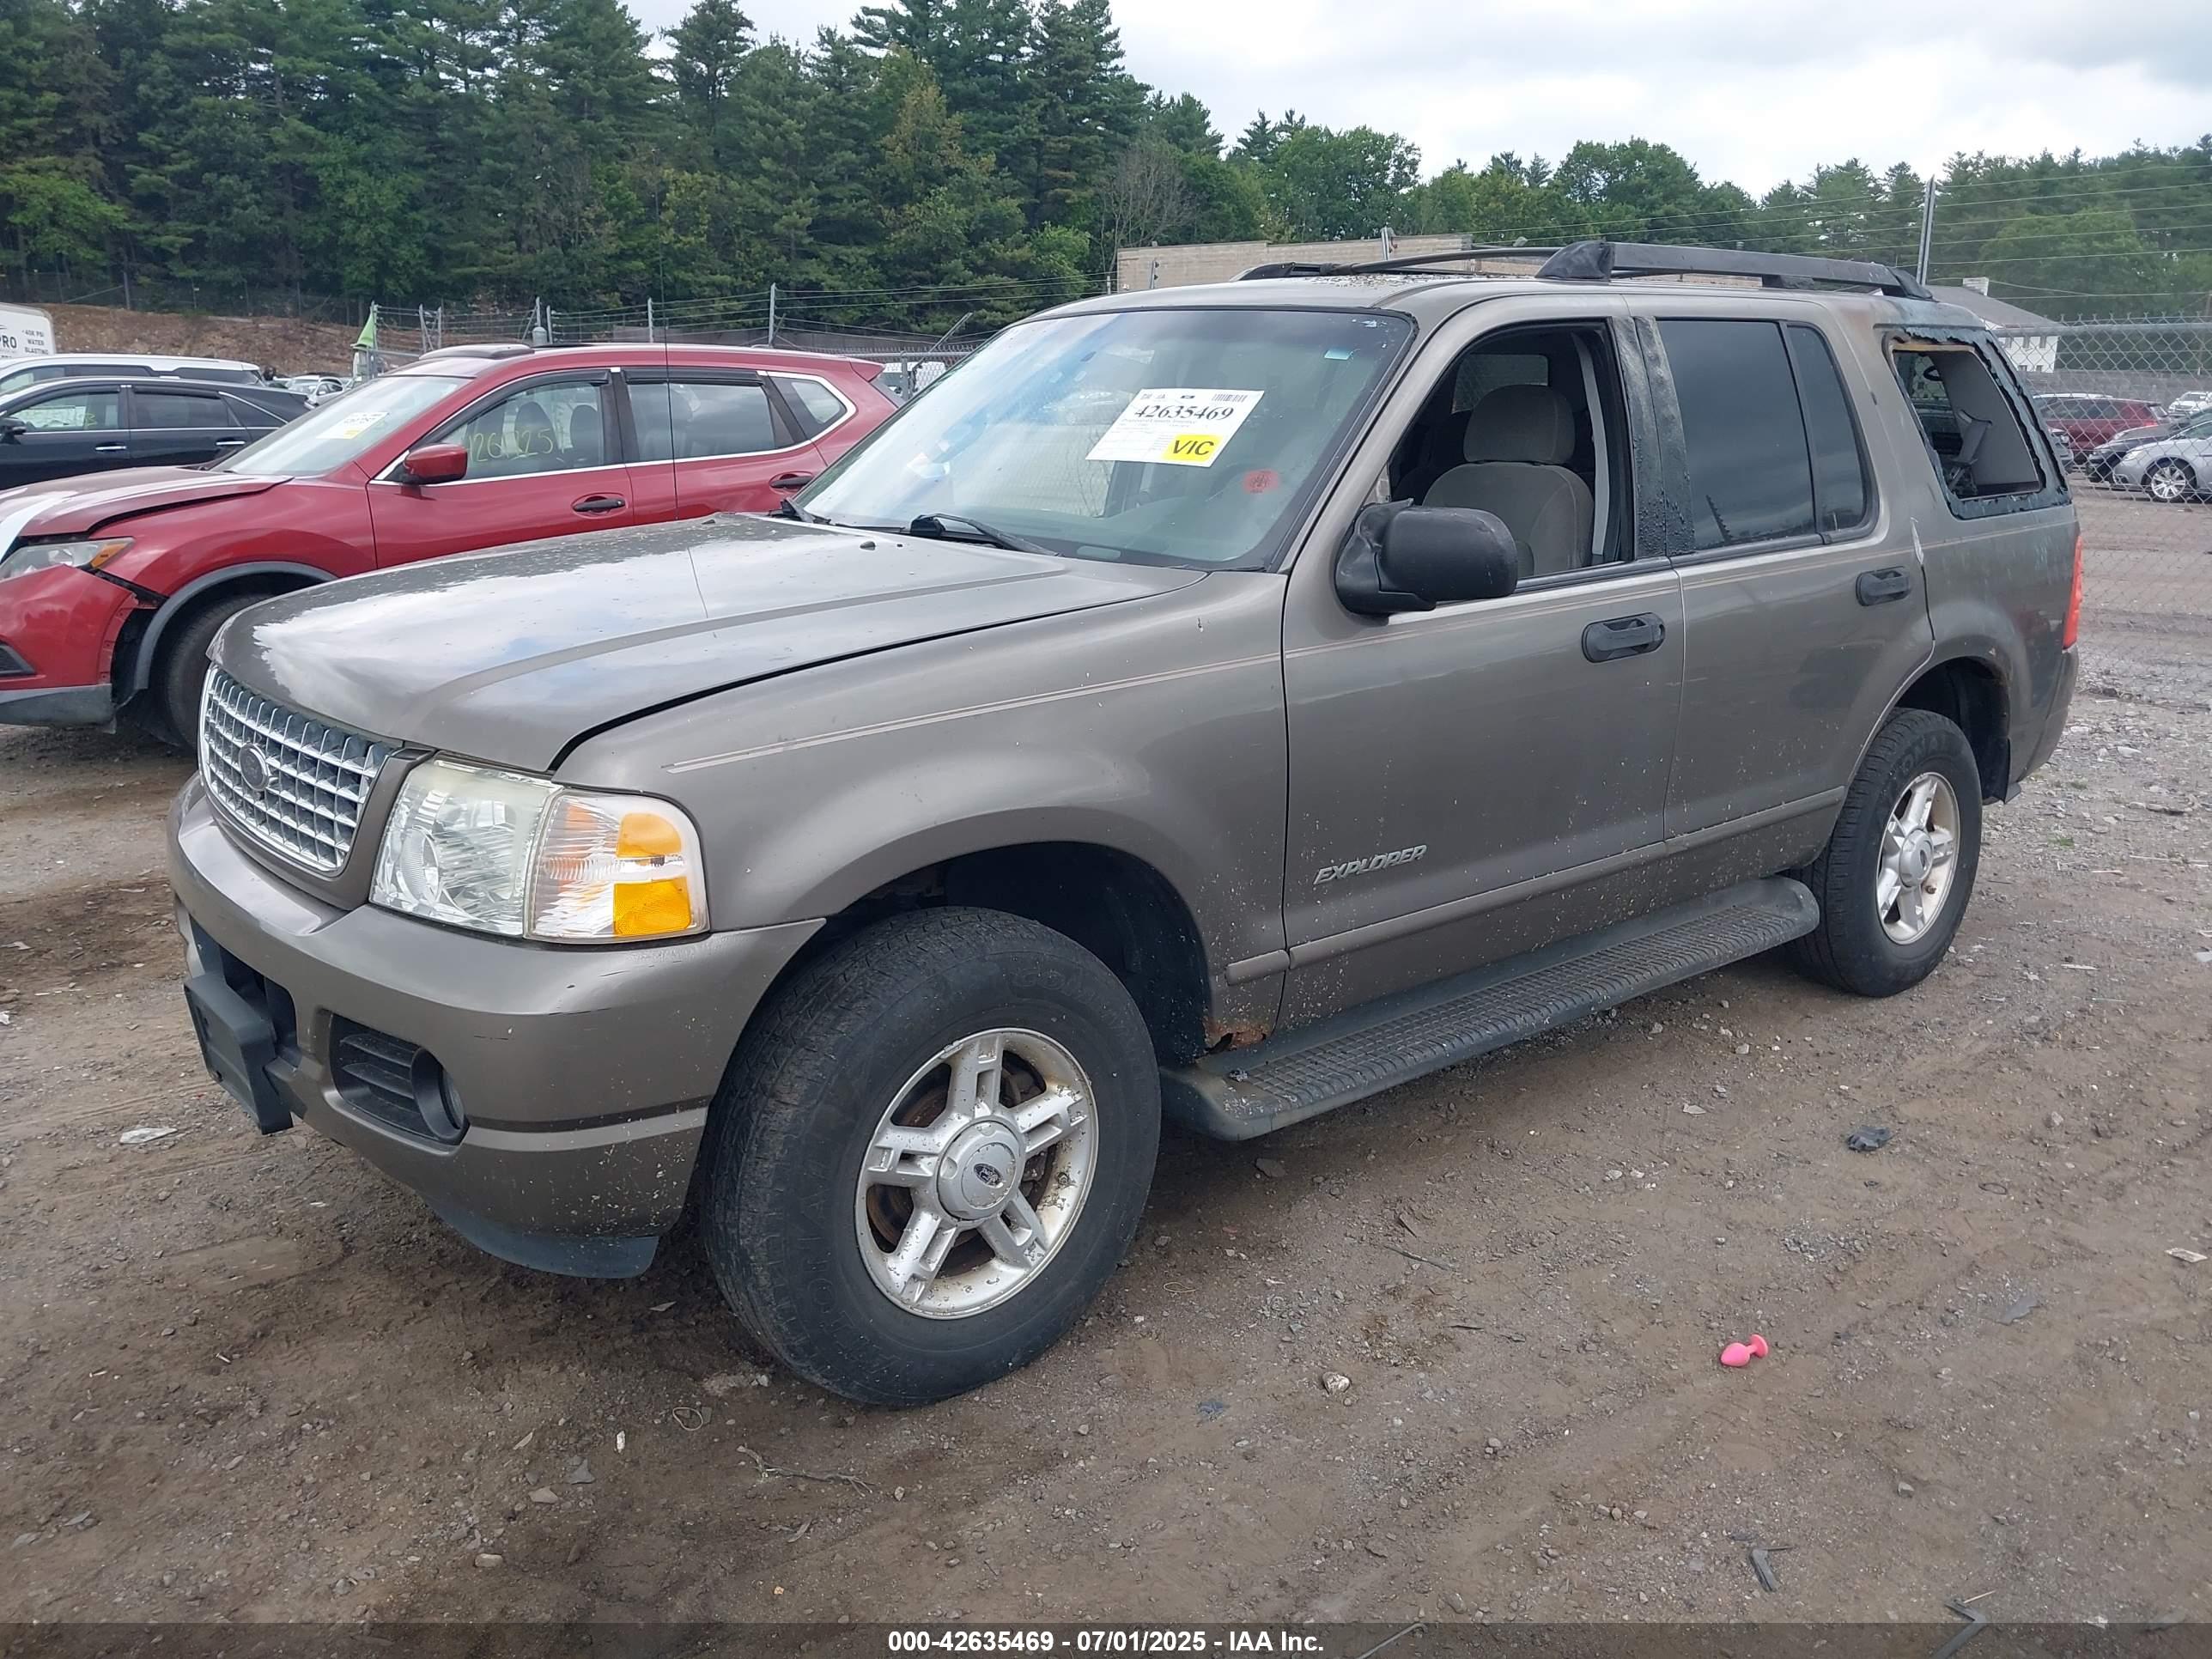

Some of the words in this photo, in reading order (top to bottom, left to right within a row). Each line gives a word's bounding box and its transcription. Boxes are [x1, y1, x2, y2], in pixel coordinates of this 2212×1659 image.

[1134, 405, 1234, 421] 42635469
[1173, 440, 1214, 455] VIC
[1313, 845, 1427, 884] EXPLORER
